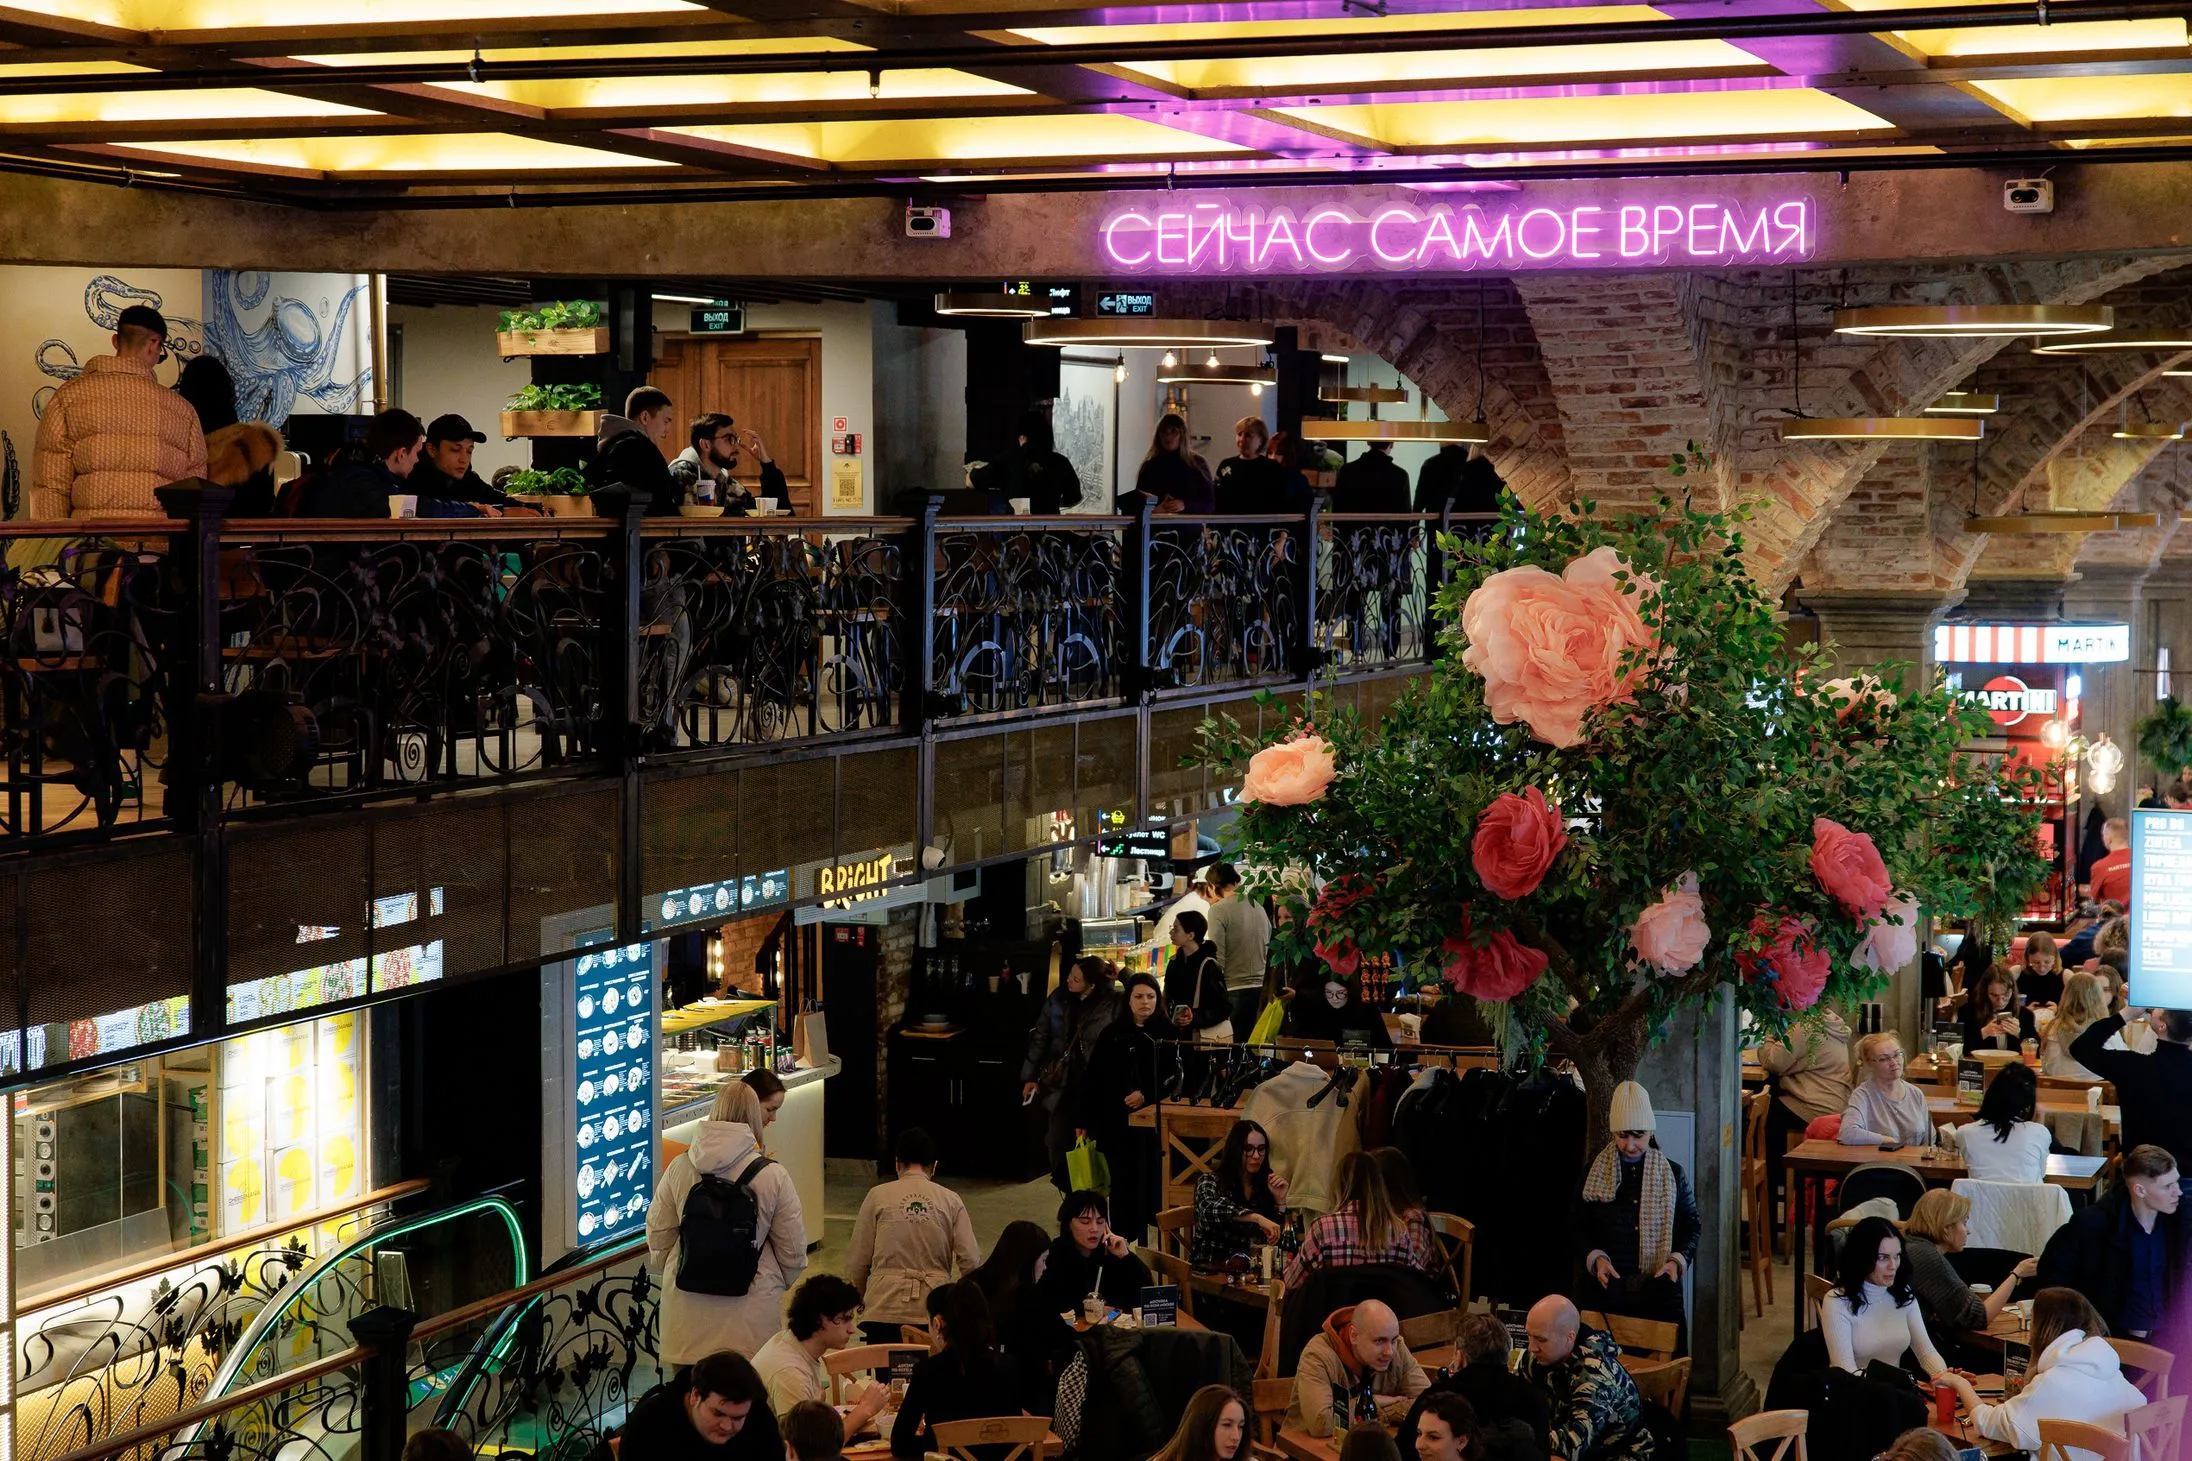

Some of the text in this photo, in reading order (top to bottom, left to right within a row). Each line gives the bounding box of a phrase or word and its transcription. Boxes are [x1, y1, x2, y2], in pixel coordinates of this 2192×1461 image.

[1105, 201, 1807, 266] СЕЙЧАС САМОЕ ВРЕМЯ
[1127, 295, 1152, 306] ВЫХОД
[1132, 305, 1148, 313] EXIT
[703, 312, 729, 323] ВЫХОД
[709, 322, 724, 330] EXIT
[1152, 830, 1166, 840] WC
[1130, 846, 1166, 857] Лестница
